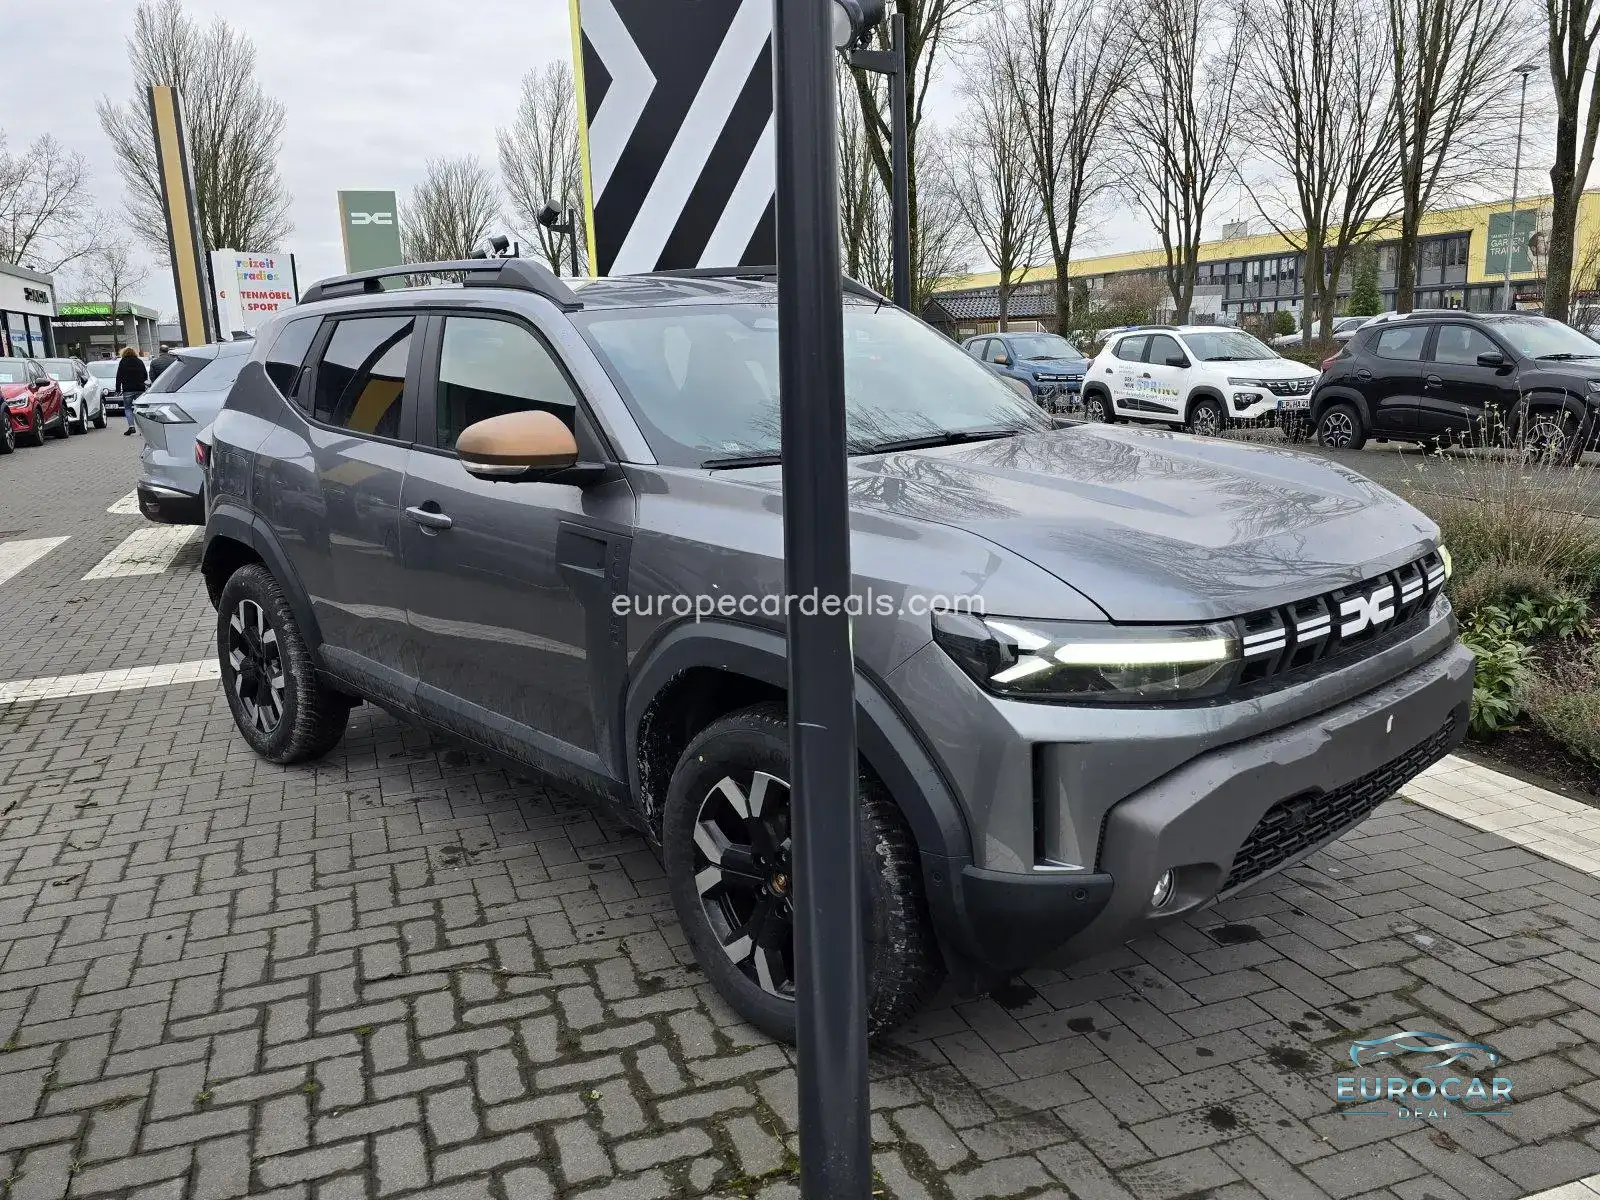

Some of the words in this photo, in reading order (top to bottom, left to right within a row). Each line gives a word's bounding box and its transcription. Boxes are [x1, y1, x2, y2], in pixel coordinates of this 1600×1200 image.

[1490, 236, 1525, 248] GAREN
[235, 257, 275, 269] reizeit
[219, 289, 292, 300] GTENMÖBEL
[247, 303, 279, 311] SPORT
